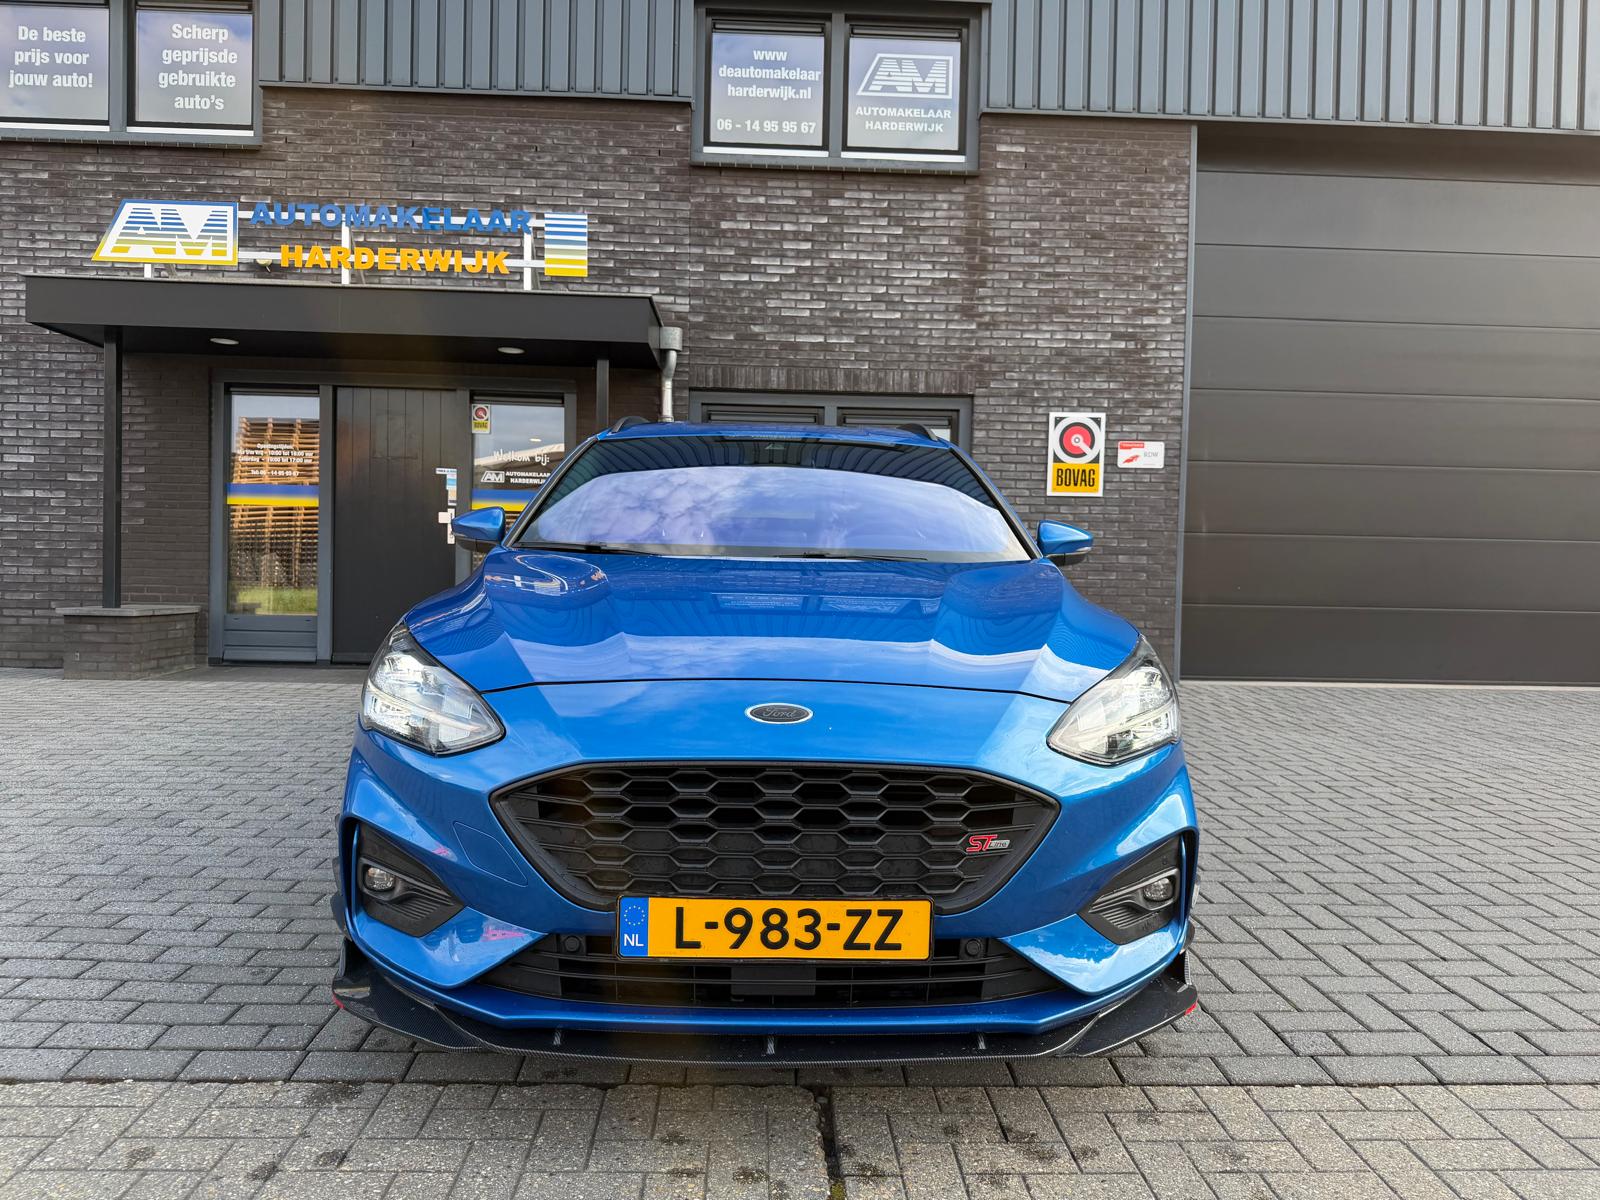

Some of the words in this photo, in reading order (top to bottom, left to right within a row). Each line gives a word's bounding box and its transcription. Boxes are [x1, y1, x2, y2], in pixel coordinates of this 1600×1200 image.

[18, 26, 38, 41] De
[43, 27, 86, 42] beste
[172, 24, 229, 43] Scherp
[15, 49, 50, 66] prijs
[54, 52, 89, 65] voor
[162, 48, 238, 66] geprijsde
[753, 50, 787, 61] www
[8, 70, 48, 88] jouw
[52, 72, 93, 88] auto!
[158, 70, 236, 88] gebruikte
[718, 65, 821, 81] deautomakelaar
[727, 84, 812, 101] harderwijk.nl
[174, 95, 225, 110] auto's
[855, 106, 952, 119] AUTOMAKELAAR
[716, 118, 733, 131] 06
[745, 119, 760, 132] 14
[763, 120, 779, 133] 95
[782, 120, 798, 133] 95
[800, 121, 817, 134] 67
[865, 120, 944, 133] HARDERWIJK
[250, 201, 532, 235] AUTOMAKELAAR
[280, 244, 510, 274] HARDERWIJK
[494, 449, 530, 462] Welkom
[1056, 468, 1096, 488] BOVAG
[762, 705, 797, 718] Ford
[966, 834, 998, 852] ST
[675, 906, 904, 952] L-983-ZZ
[624, 933, 645, 947] NL
